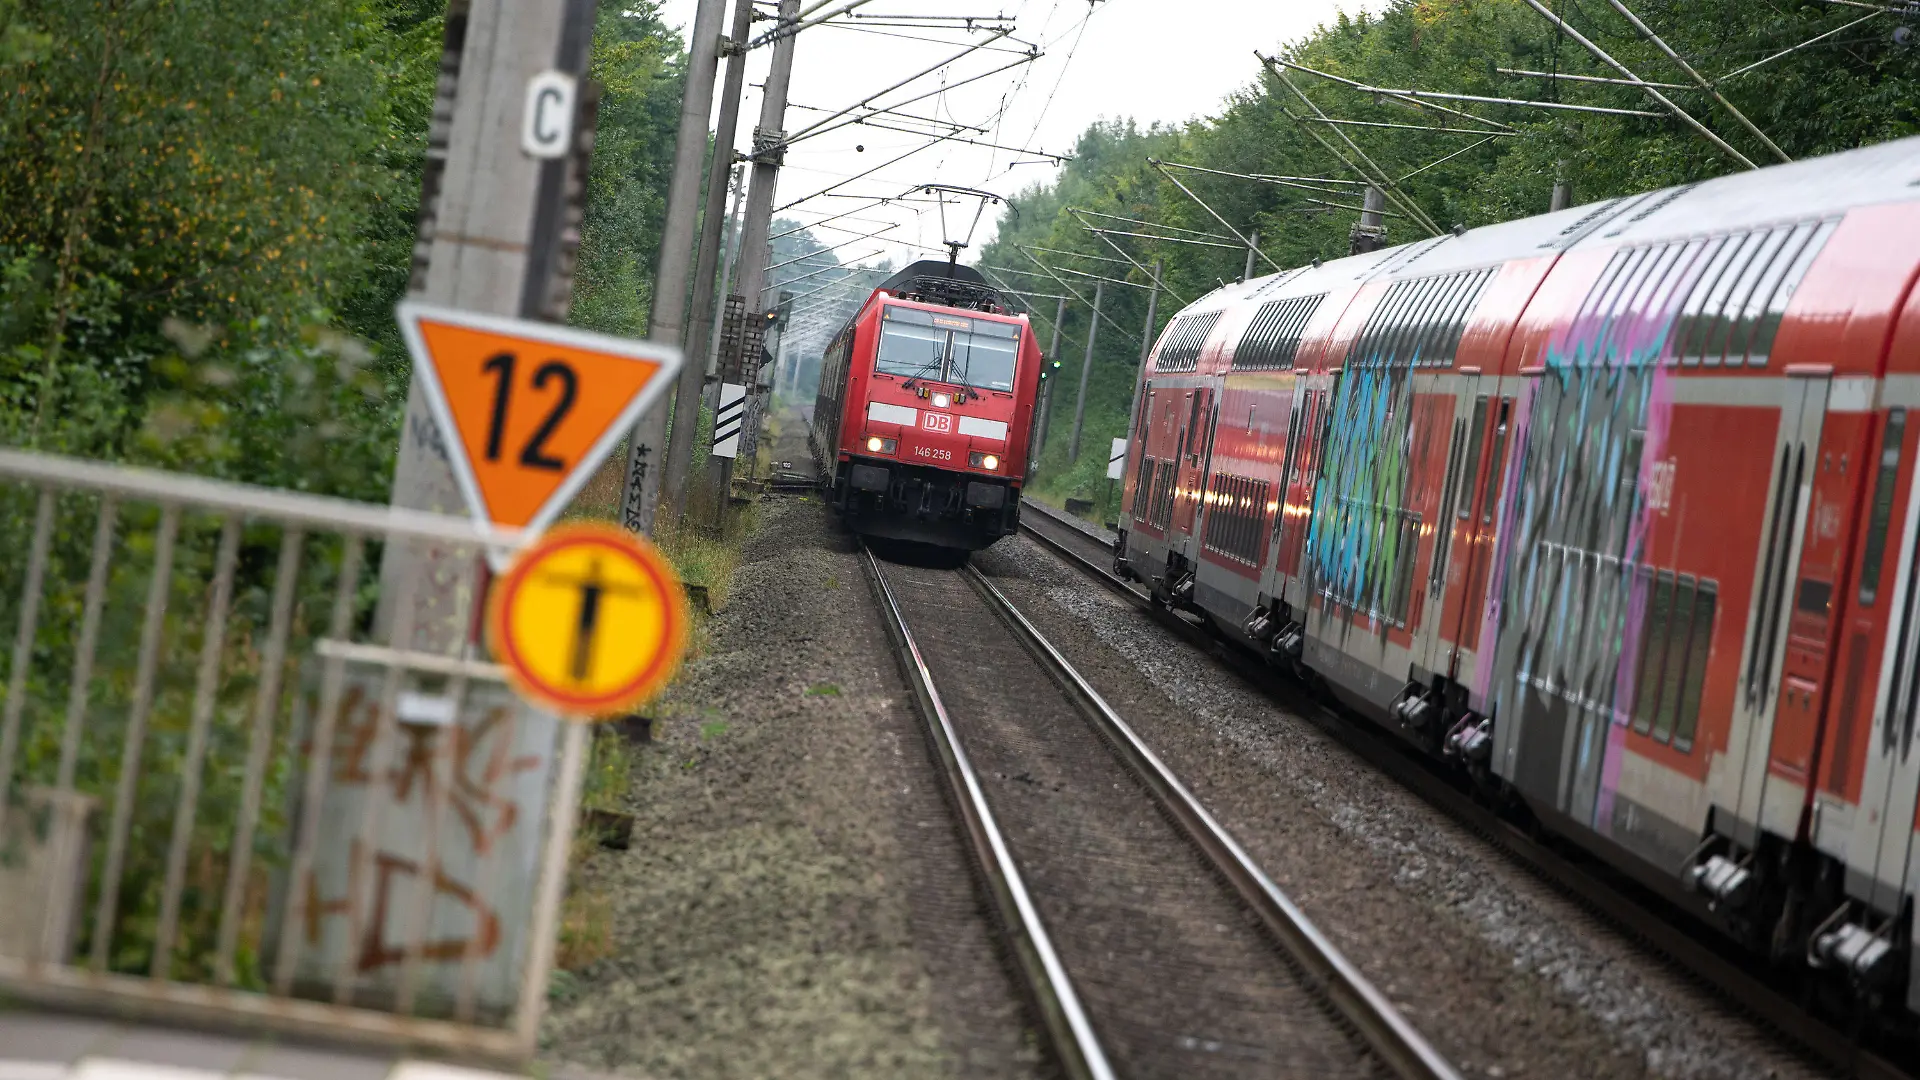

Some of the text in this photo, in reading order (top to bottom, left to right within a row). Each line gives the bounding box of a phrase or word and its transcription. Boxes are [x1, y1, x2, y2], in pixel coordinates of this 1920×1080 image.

[534, 87, 563, 145] C
[482, 352, 578, 471] 12
[925, 413, 949, 430] DB
[914, 445, 952, 460] 146 258
